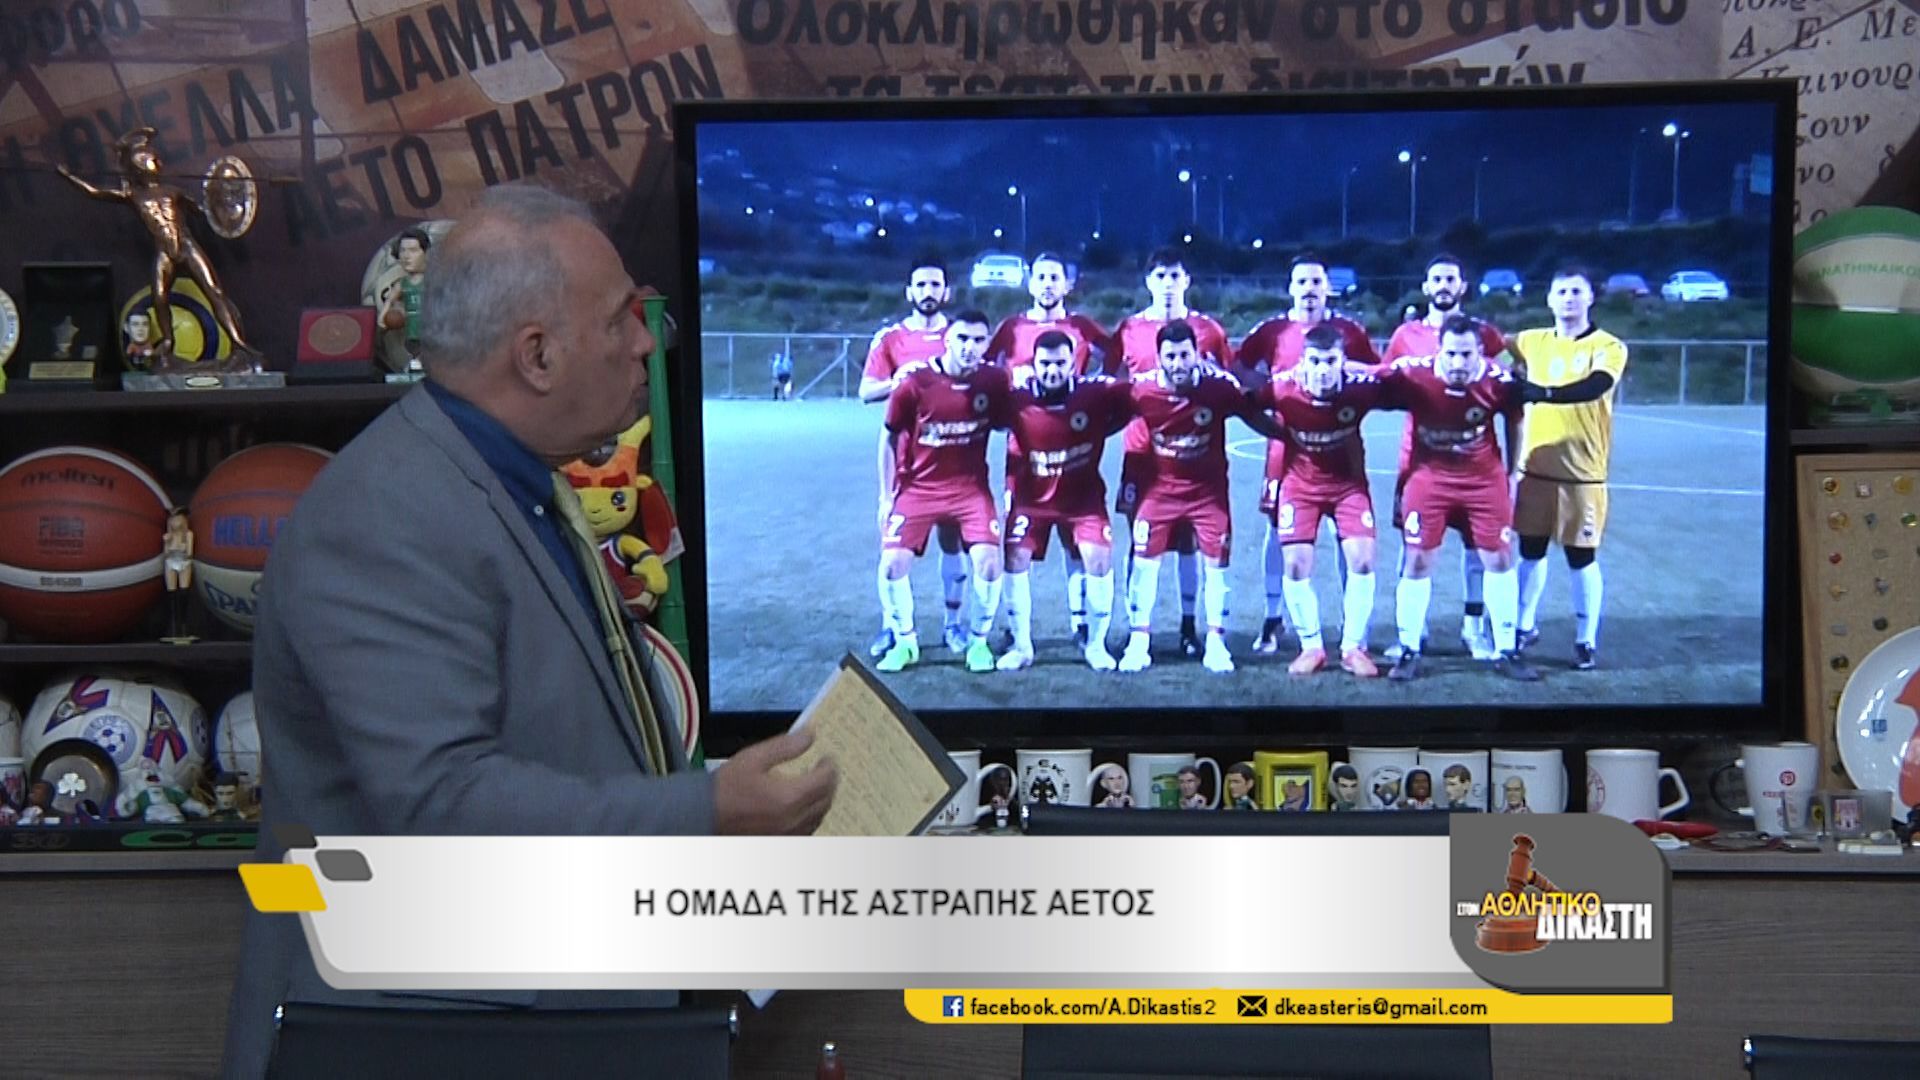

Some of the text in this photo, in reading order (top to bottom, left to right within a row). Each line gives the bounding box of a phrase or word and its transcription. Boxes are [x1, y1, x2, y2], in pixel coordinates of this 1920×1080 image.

[355, 0, 614, 103] ΔΑΜΑΣΕ
[464, 44, 726, 187] ΠΑΤΡΩΝ
[1012, 514, 1030, 537] 2
[1404, 510, 1421, 535] 4
